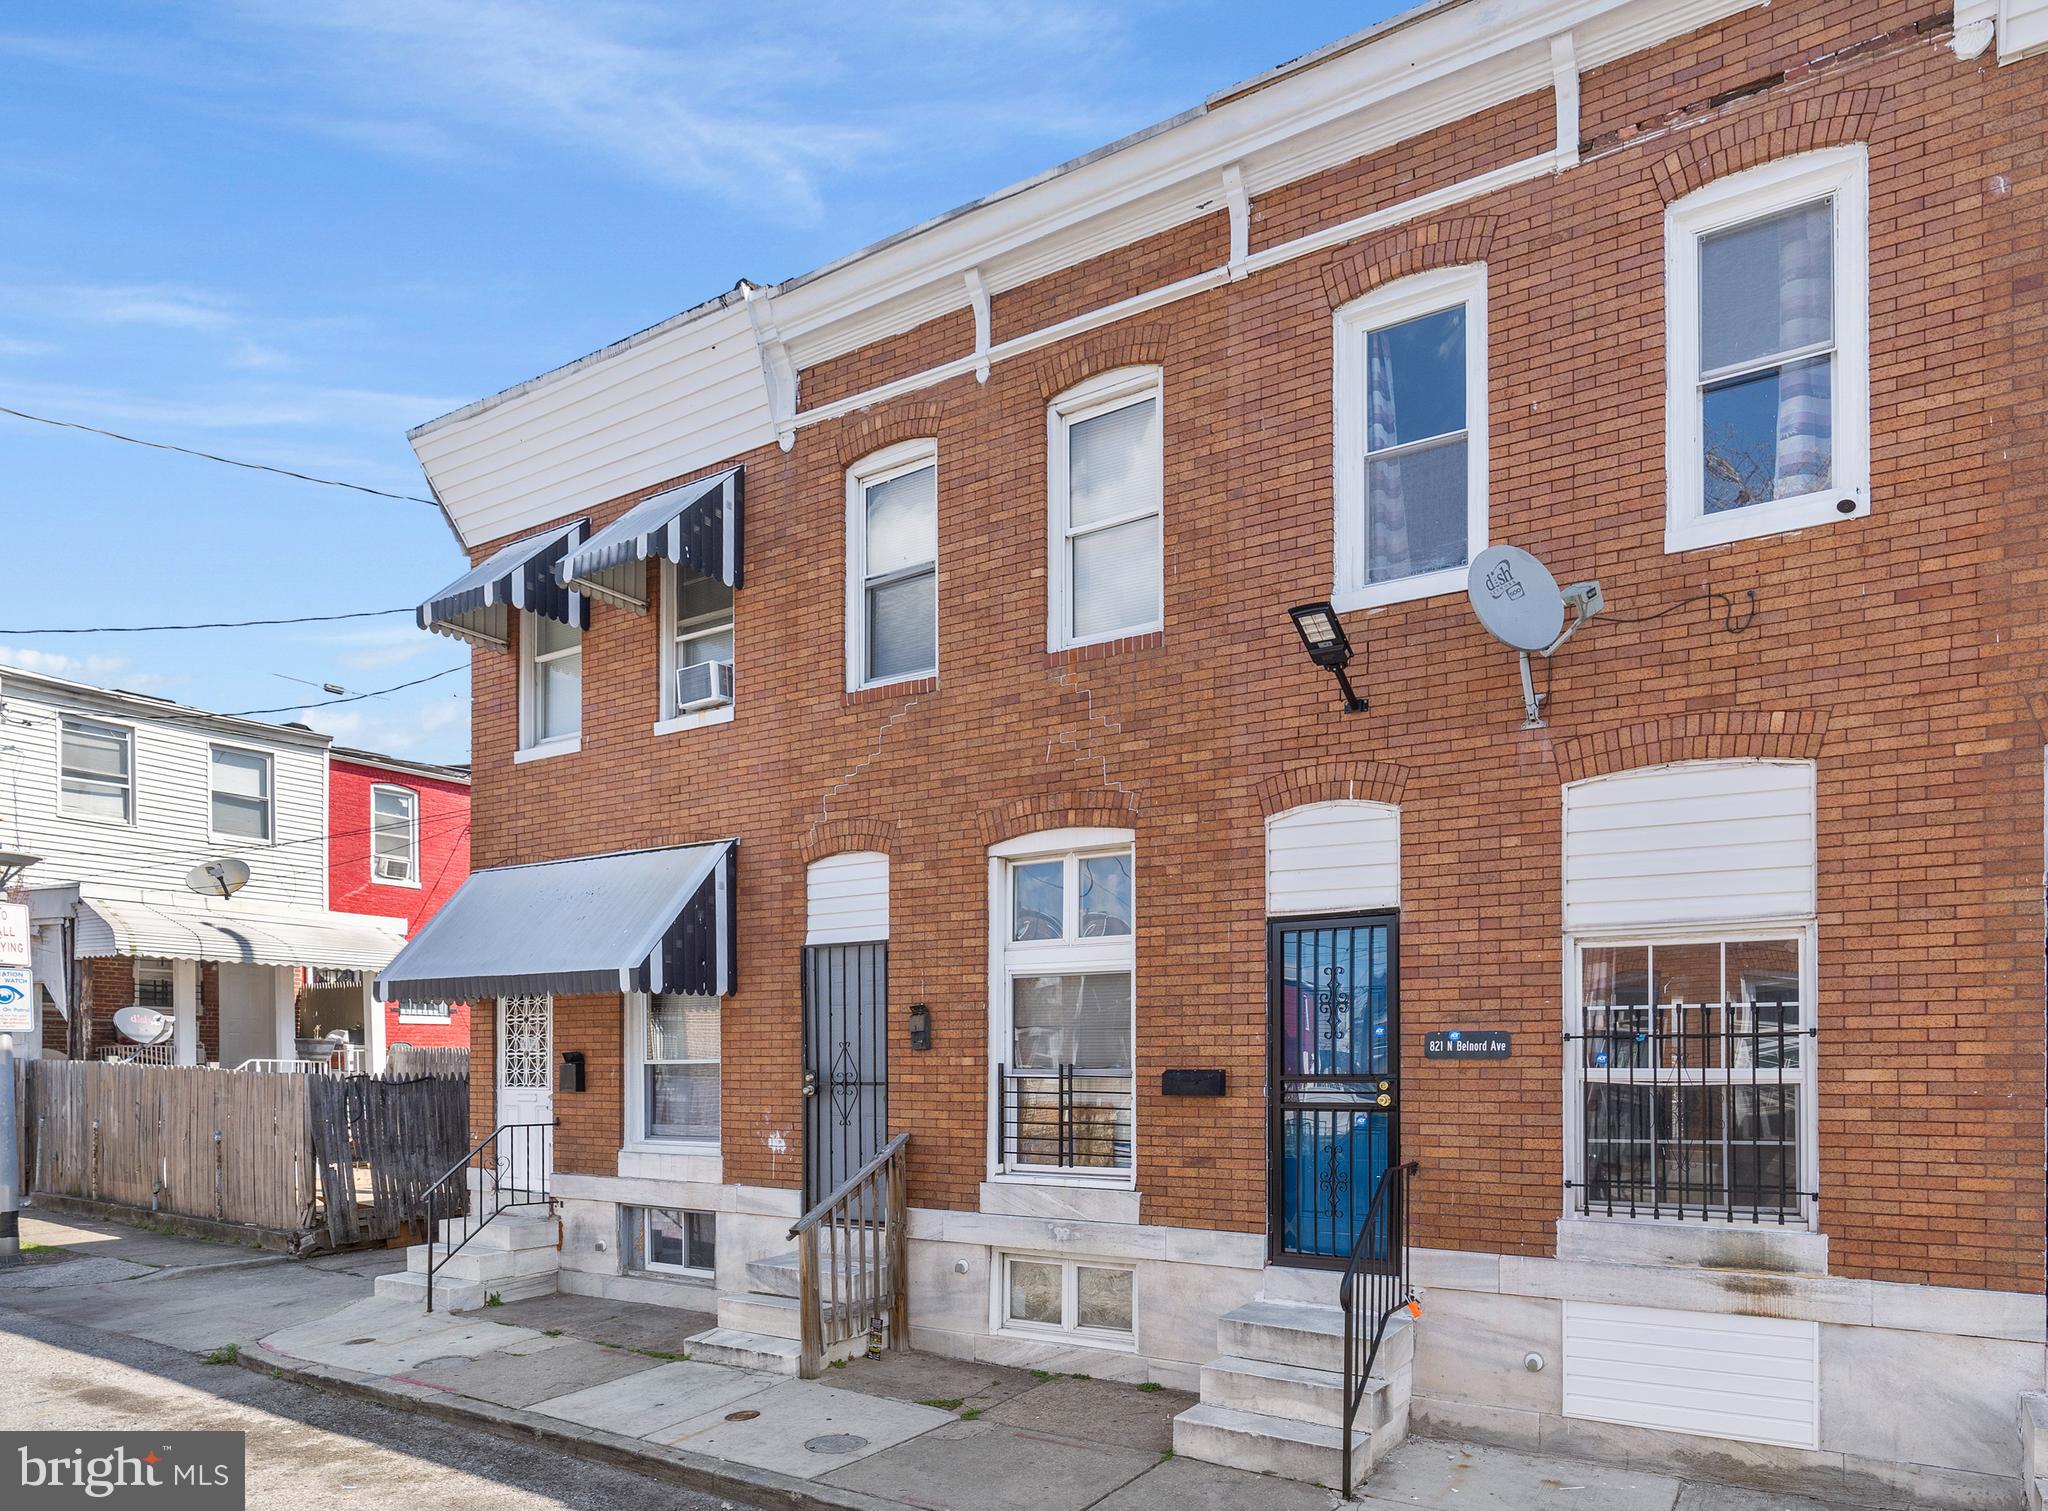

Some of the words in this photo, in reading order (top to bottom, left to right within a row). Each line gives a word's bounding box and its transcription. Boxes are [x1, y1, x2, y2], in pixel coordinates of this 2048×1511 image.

[1486, 566, 1514, 591] dish
[1429, 1040, 1443, 1052] 821
[1447, 1040, 1453, 1052] N
[1456, 1040, 1487, 1052] Belnord
[1490, 1040, 1506, 1052] Ave
